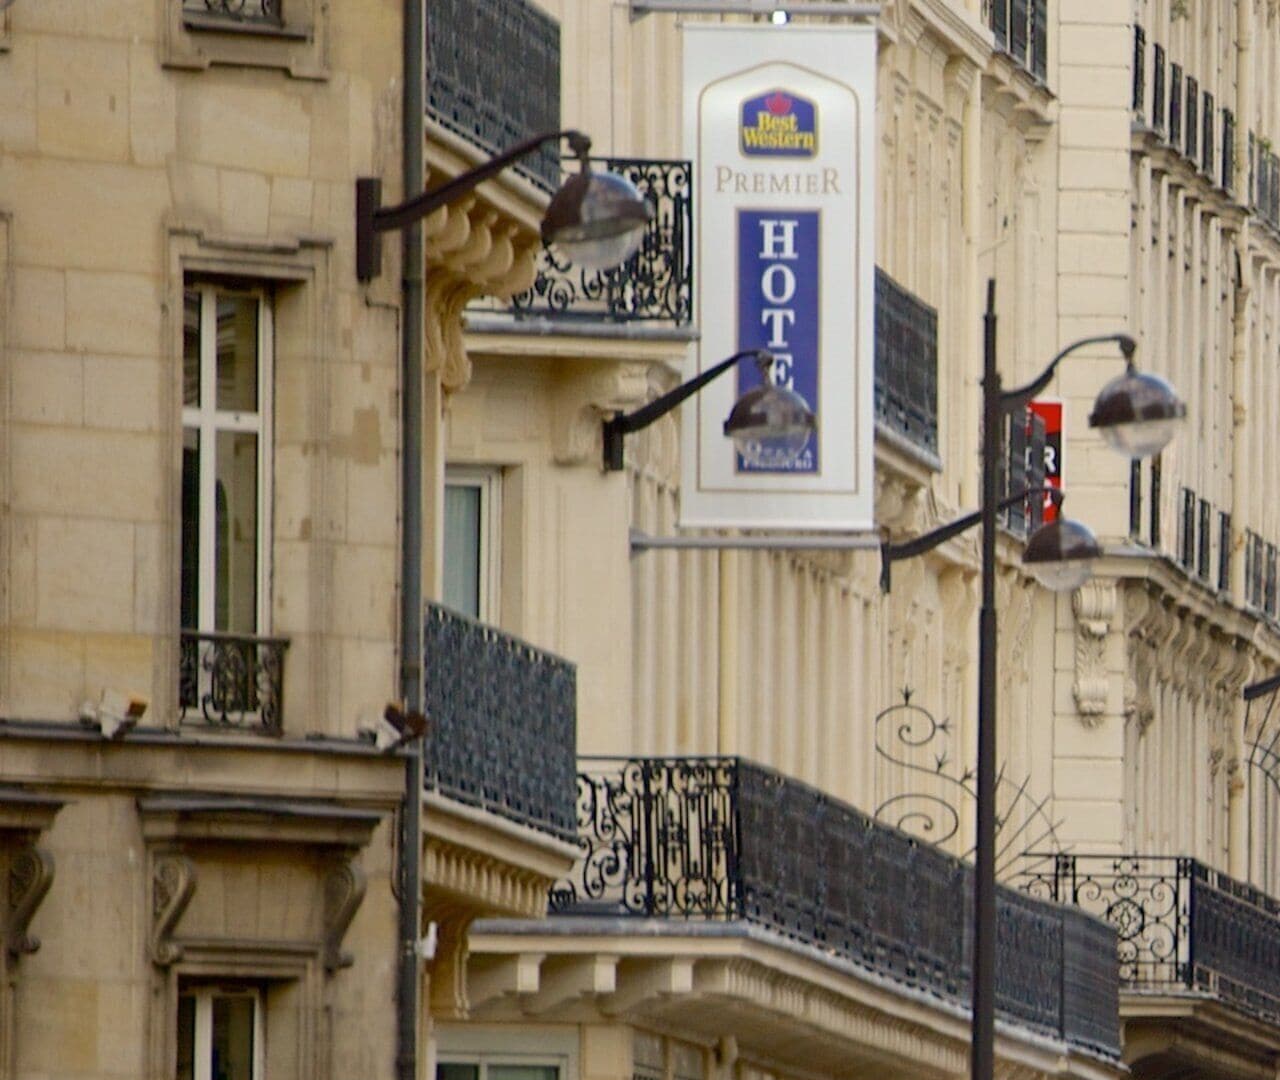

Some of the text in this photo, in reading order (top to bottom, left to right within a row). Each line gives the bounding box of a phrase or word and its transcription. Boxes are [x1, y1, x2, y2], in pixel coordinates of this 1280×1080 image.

[757, 111, 798, 131] Best
[744, 127, 816, 149] Western
[715, 165, 841, 194] PREMIER
[757, 219, 799, 392] HOTE
